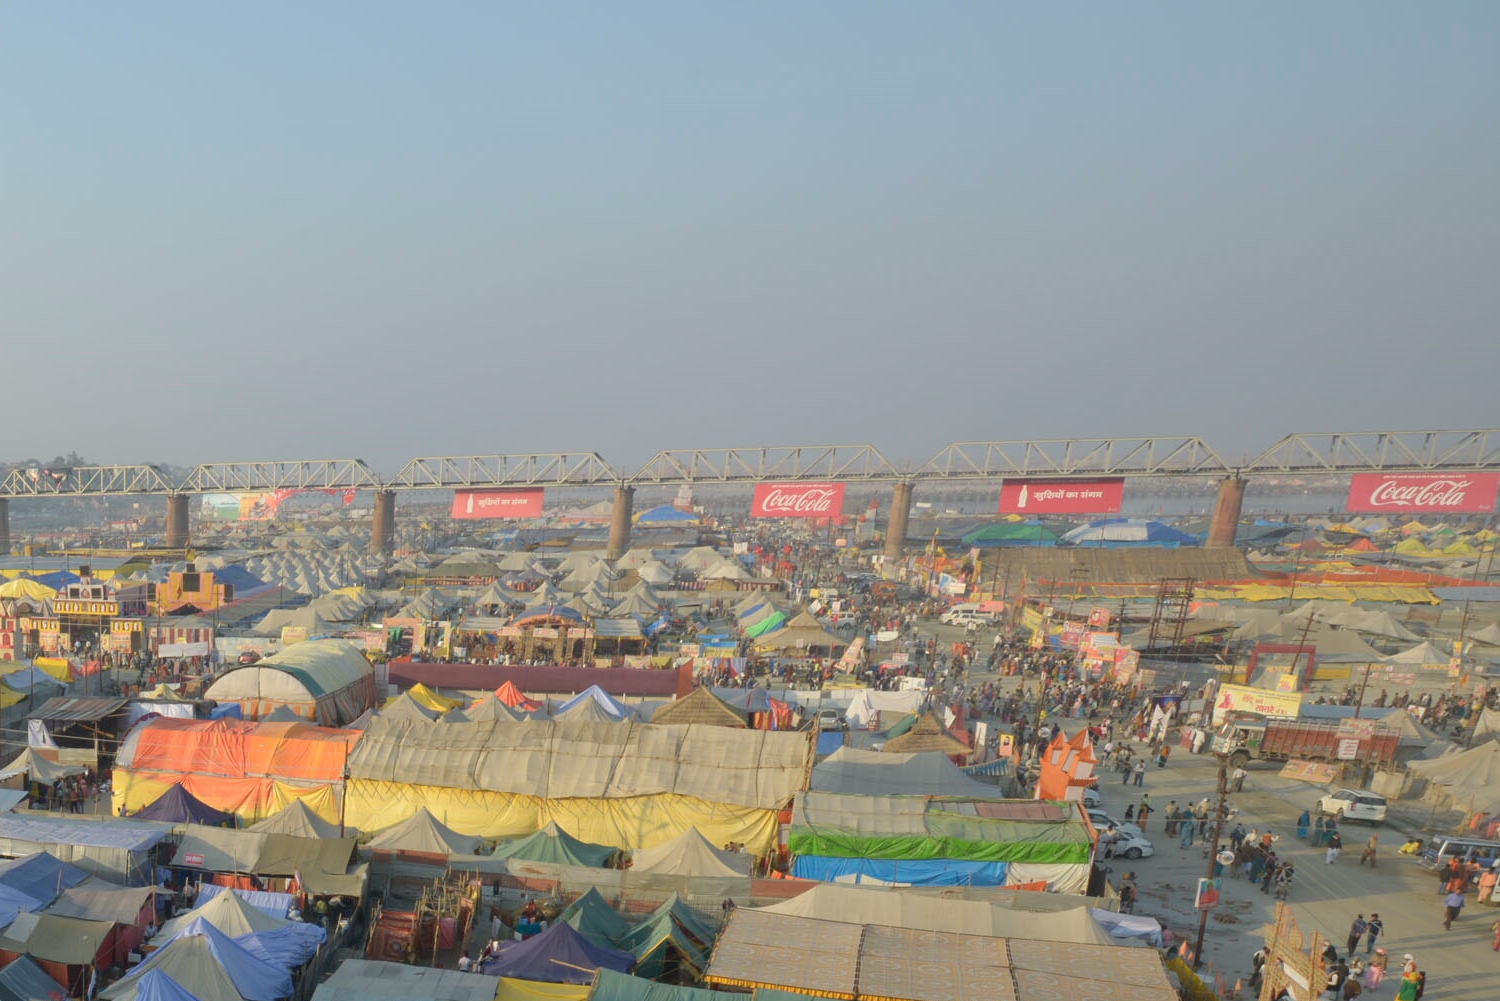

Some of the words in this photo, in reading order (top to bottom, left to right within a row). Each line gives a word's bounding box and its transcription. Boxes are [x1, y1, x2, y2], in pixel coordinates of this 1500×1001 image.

[762, 489, 836, 511] Coca-Cola
[1034, 489, 1065, 501] खुशियों
[1066, 491, 1078, 499] का
[1080, 489, 1103, 499] संगम
[1370, 480, 1474, 506] Coca-Cola
